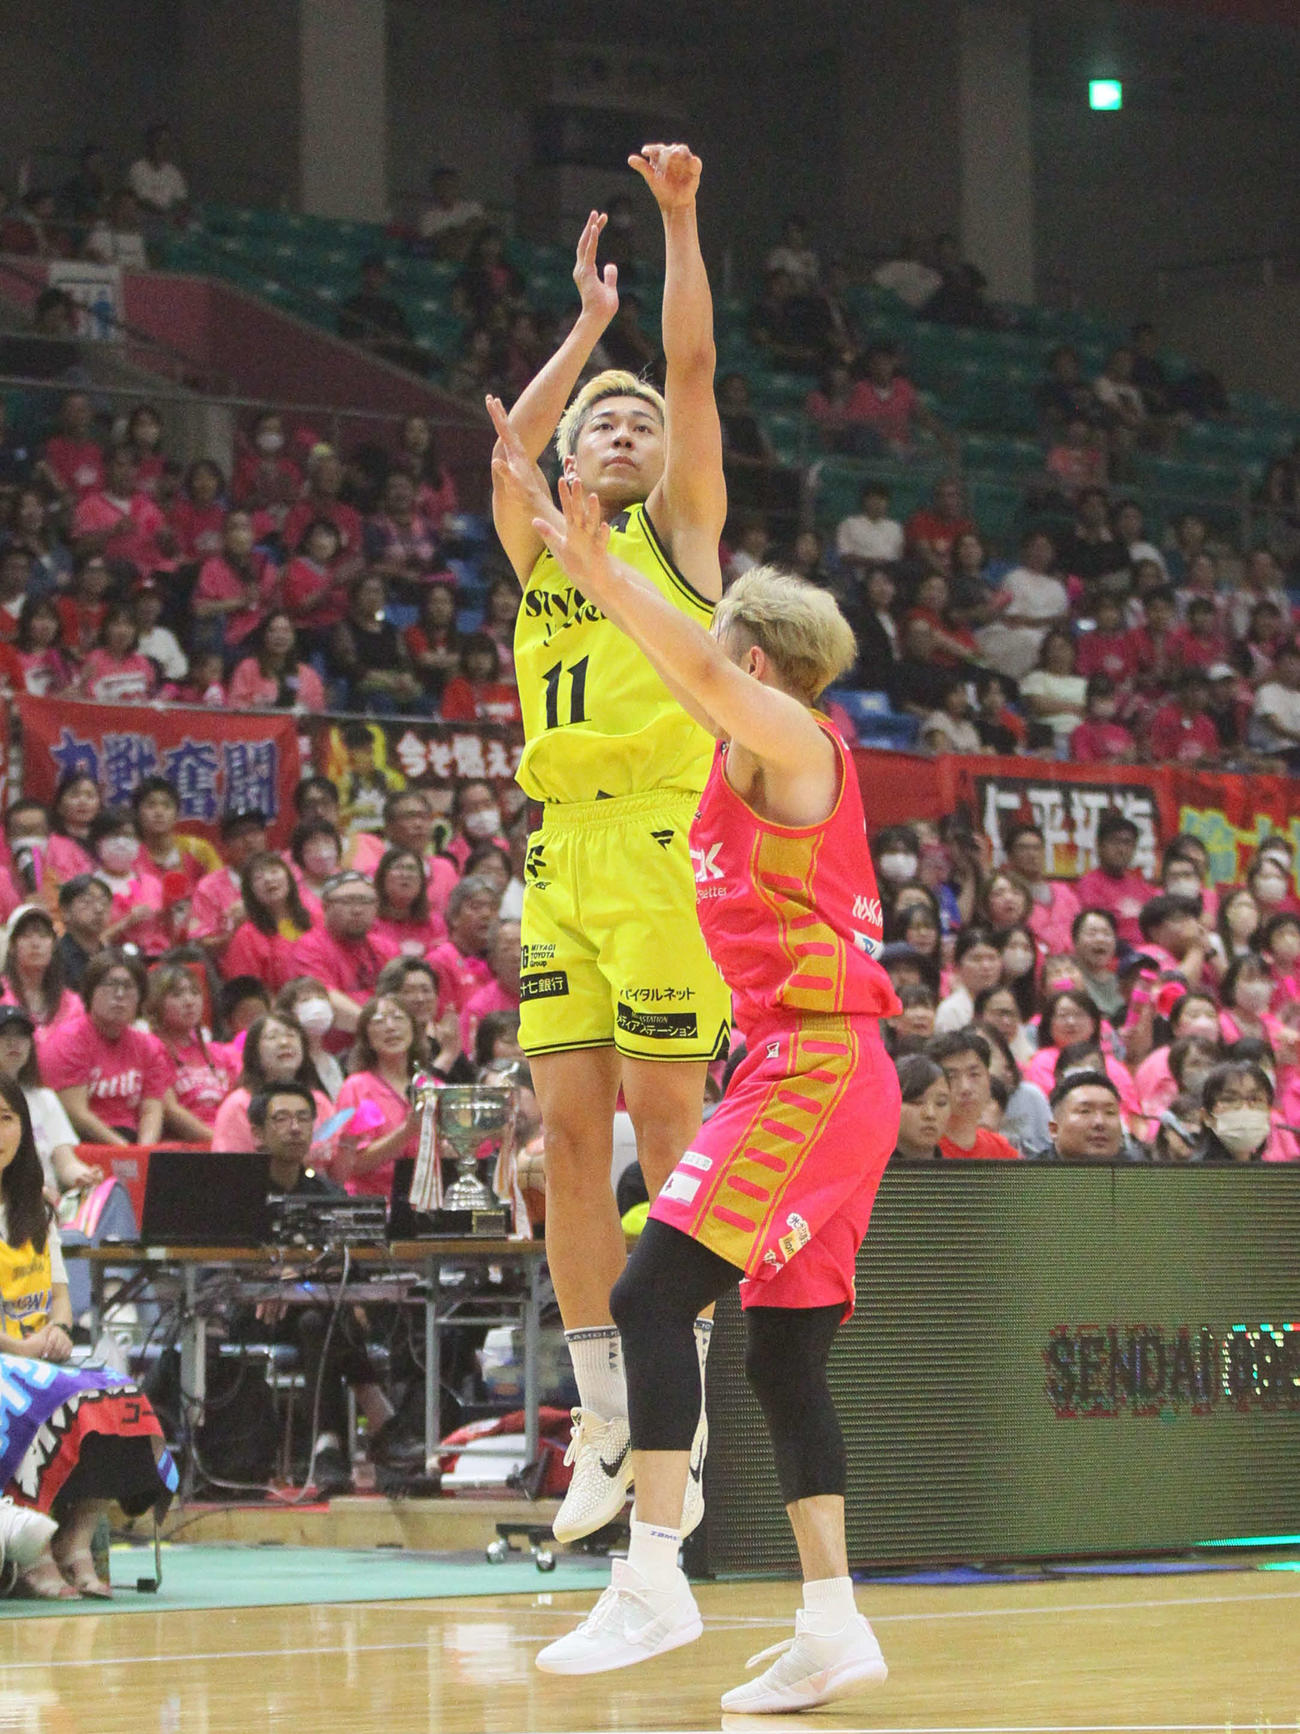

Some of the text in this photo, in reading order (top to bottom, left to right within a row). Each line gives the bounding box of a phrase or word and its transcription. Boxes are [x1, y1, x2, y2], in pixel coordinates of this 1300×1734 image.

[541, 655, 592, 731] 11
[530, 951, 555, 959] TOYOTA
[519, 976, 564, 998] 十七銀行
[620, 987, 695, 1001] バイタルネット
